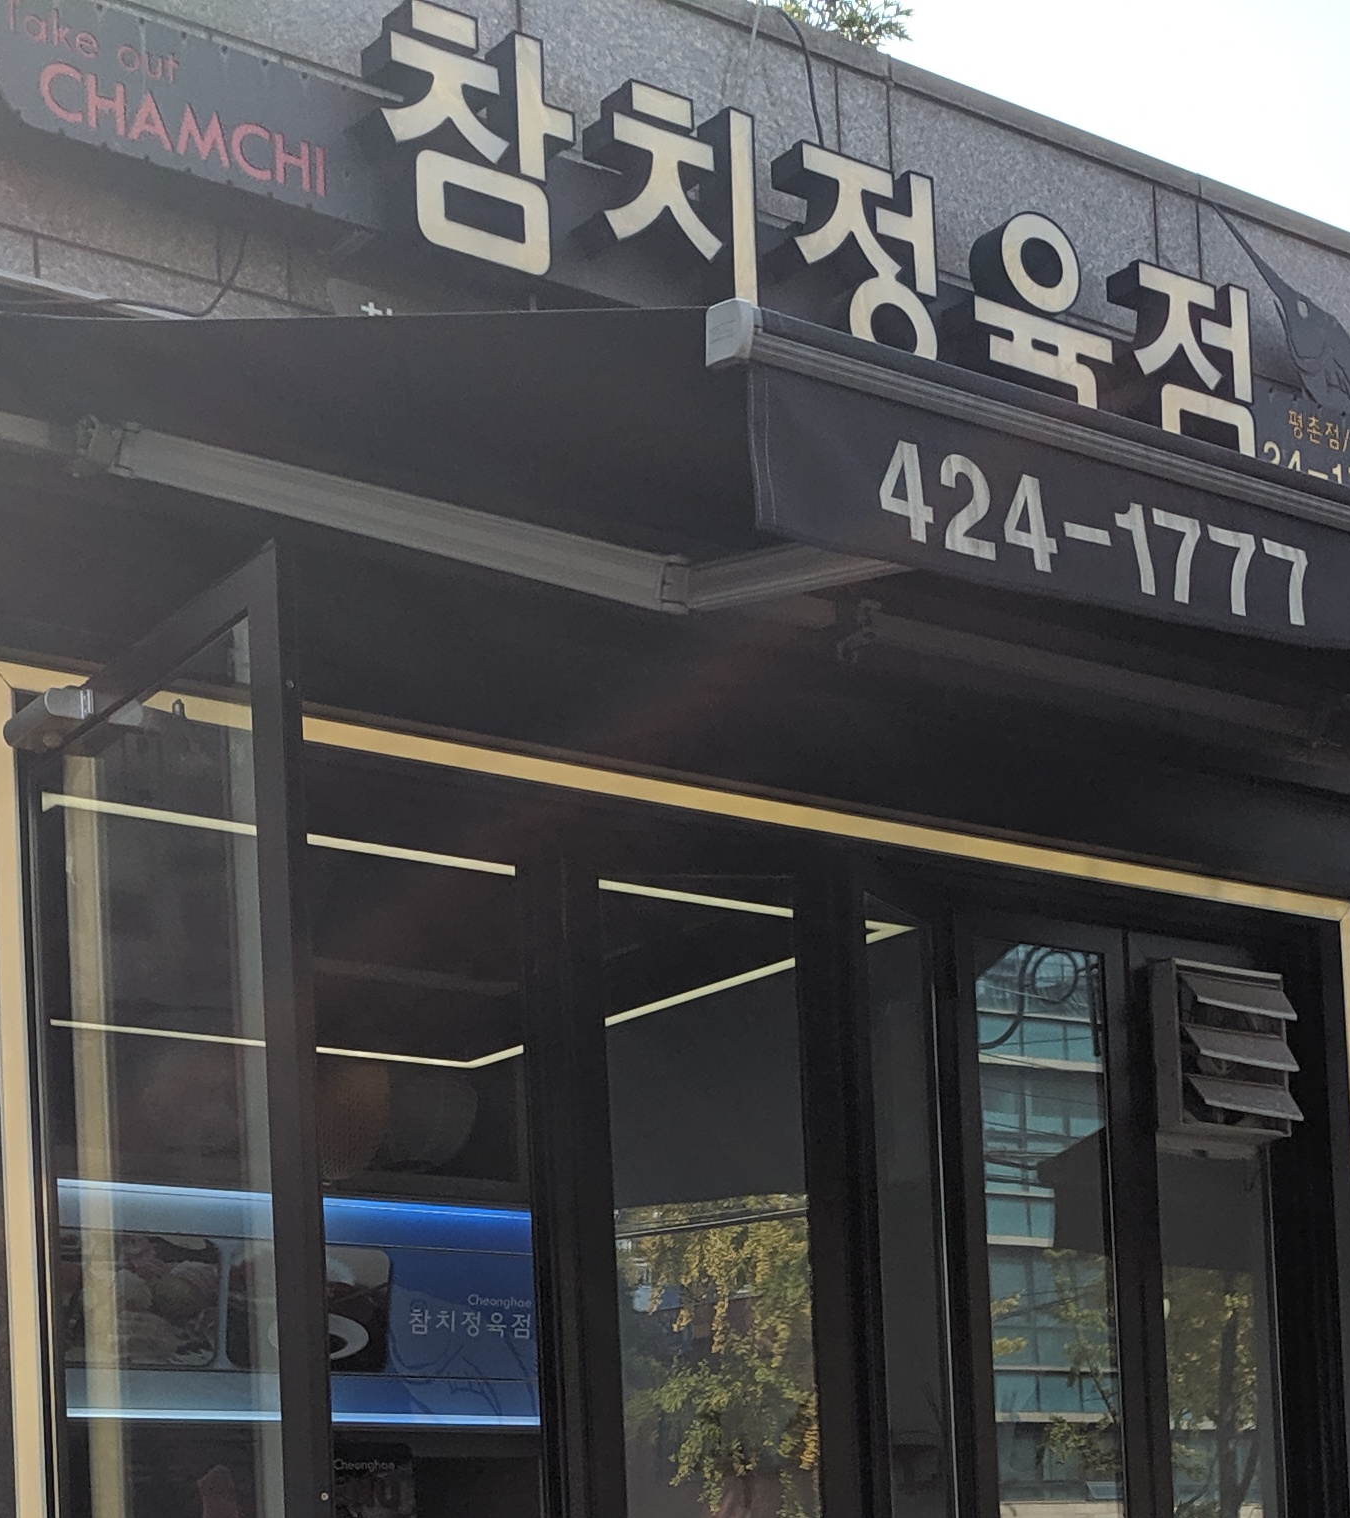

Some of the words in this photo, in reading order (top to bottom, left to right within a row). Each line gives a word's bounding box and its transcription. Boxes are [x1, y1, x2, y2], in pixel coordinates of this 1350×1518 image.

[6, 0, 98, 58] Take
[117, 44, 180, 84] out
[39, 61, 327, 198] CHAMCHI
[379, 0, 1256, 457] 참치정육점
[879, 440, 1308, 627] 424-1777
[409, 1308, 532, 1339] 참치정육점
[467, 1293, 532, 1310] Cheonghae
